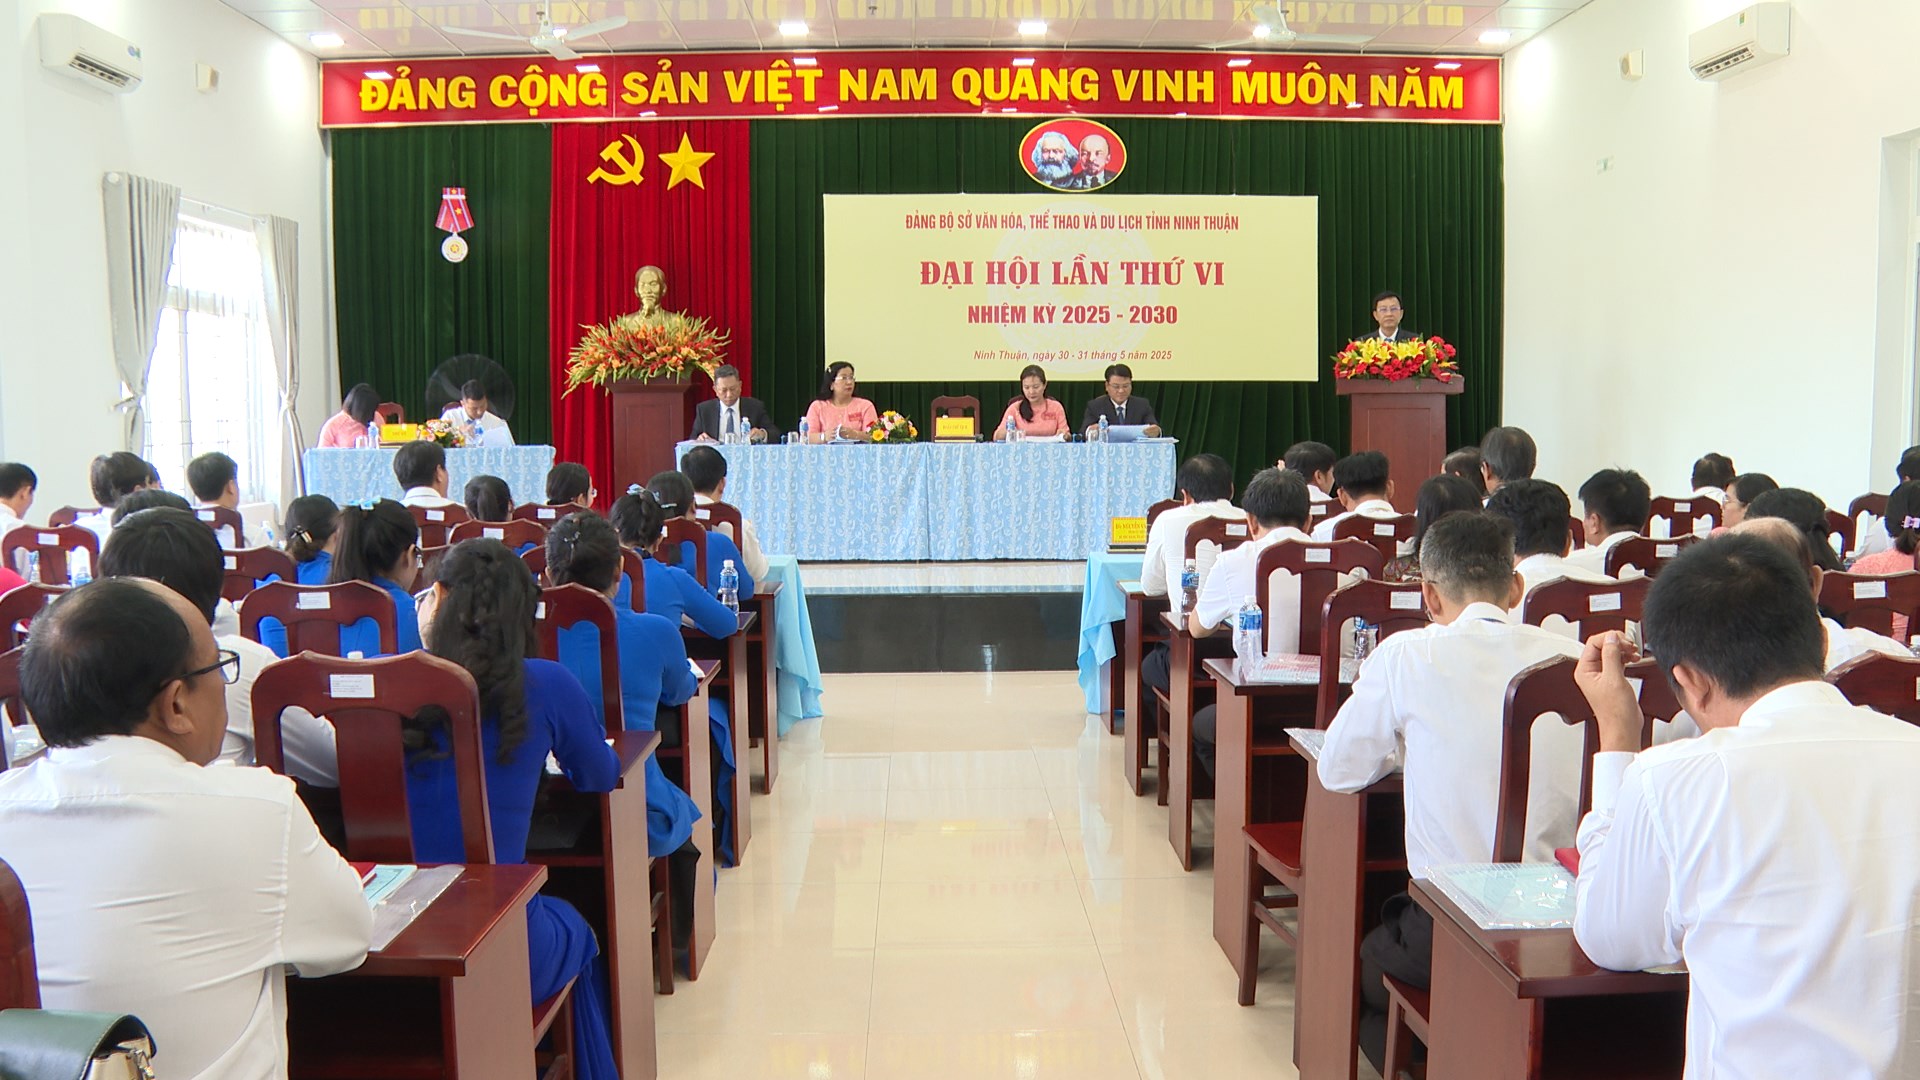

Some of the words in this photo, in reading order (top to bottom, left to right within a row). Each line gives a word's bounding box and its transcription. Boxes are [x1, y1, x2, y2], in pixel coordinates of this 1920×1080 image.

[359, 65, 476, 111] ĐẢNG
[489, 65, 608, 115] CỘNG
[619, 59, 708, 104] SẢN
[722, 59, 823, 111] VIỆT
[839, 68, 938, 101] NAM
[951, 67, 1099, 106] QUANG
[1114, 69, 1215, 103] VINH
[1231, 62, 1356, 106] MUÔN
[1370, 66, 1464, 109] NĂM
[905, 210, 936, 229] ĐẢNG
[939, 211, 954, 232] BỘ
[957, 209, 972, 229] SỞ
[975, 211, 998, 229] VĂN
[1001, 211, 1027, 231] HÓA,
[1029, 209, 1050, 229] THỂ
[1053, 214, 1081, 229] THAO
[1083, 211, 1097, 229] VÀ
[1100, 214, 1115, 229] DU
[1118, 215, 1143, 232] LỊCH
[1145, 210, 1171, 230] TỈNH
[1173, 215, 1201, 230] NINH
[1203, 212, 1239, 234] THUẬN
[920, 260, 974, 289] ĐẠI
[985, 256, 1040, 289] HỘI
[1052, 253, 1109, 286] LẦN
[1120, 255, 1185, 286] THỨ
[1193, 261, 1225, 286] VI
[967, 303, 1027, 327] NHIỆM
[1032, 302, 1057, 324] KỲ
[1062, 305, 1111, 325] 2025
[1129, 305, 1178, 325] 2030
[973, 350, 996, 360] Ninh
[999, 350, 1030, 362] Thuận,
[1032, 350, 1056, 362] ngày
[1058, 350, 1069, 360] 30
[1077, 350, 1088, 360] 31
[1091, 350, 1118, 362] tháng
[1119, 350, 1127, 360] 5
[1127, 350, 1148, 360] năm
[1150, 350, 1173, 360] 2025
